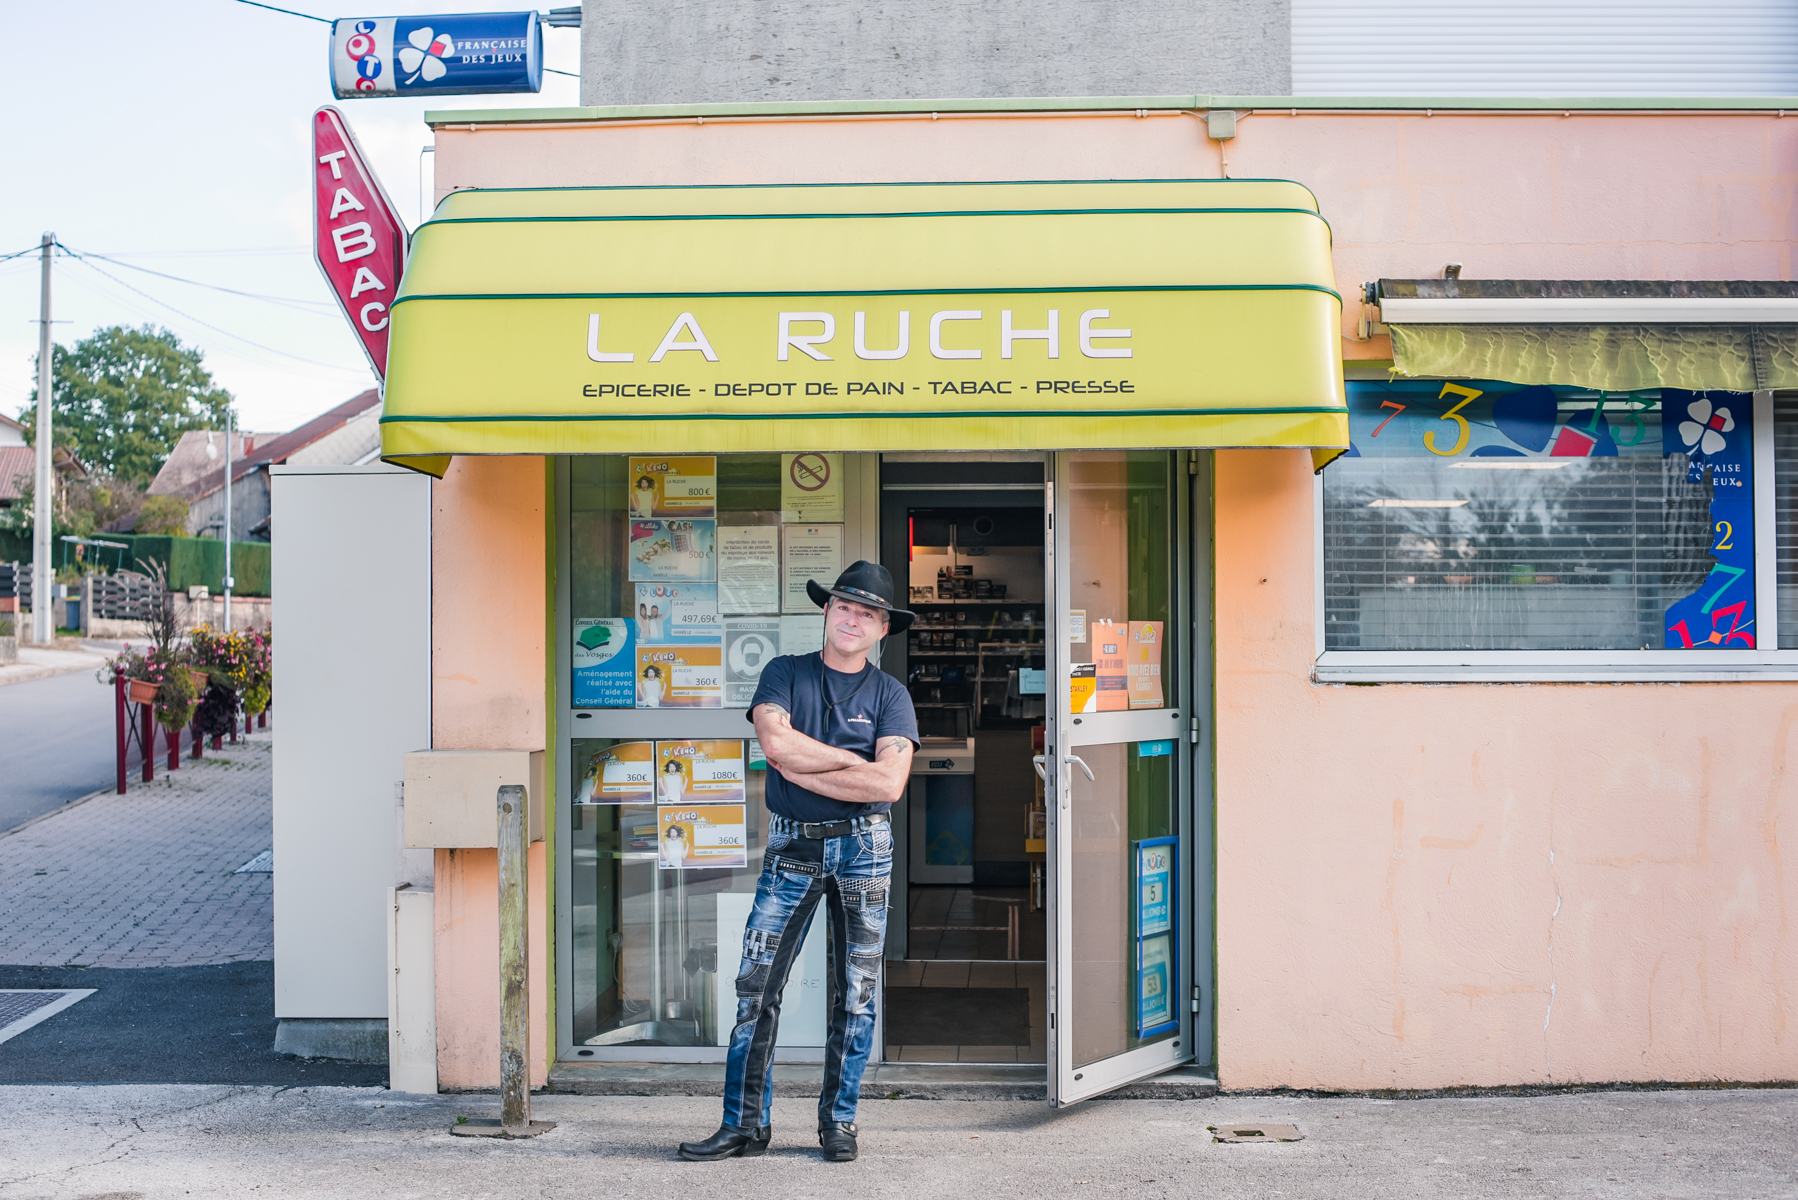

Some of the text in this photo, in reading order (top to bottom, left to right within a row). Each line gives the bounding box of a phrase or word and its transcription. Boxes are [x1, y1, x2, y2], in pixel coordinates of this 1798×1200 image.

[462, 53, 522, 64] DES JEUX
[319, 150, 389, 333] TABAC
[586, 309, 1133, 363] LA RUCHE
[582, 383, 691, 398] EPICERIE
[714, 382, 797, 397] DEPOT
[805, 382, 838, 396] DE
[846, 381, 905, 395] PAIN
[927, 380, 1013, 395] TABAC
[1036, 379, 1136, 394] PRESSE
[1371, 400, 1407, 437] 7
[1423, 382, 1483, 456] 3
[1712, 478, 1737, 486] EUX
[688, 488, 704, 496] 800
[667, 520, 694, 533] CASH
[1715, 520, 1734, 550] 2
[688, 551, 704, 559] 500
[649, 584, 679, 598] LOTO
[1700, 563, 1746, 614] 7
[682, 615, 717, 624] 497,69€
[586, 651, 613, 659] Vosges
[653, 652, 675, 661] KENO
[577, 670, 633, 679] Aménagement
[673, 746, 695, 756] KENO
[626, 774, 647, 782] 360€
[675, 811, 697, 821] KENO
[1150, 885, 1156, 902] 5
[1147, 976, 1158, 994] 53
